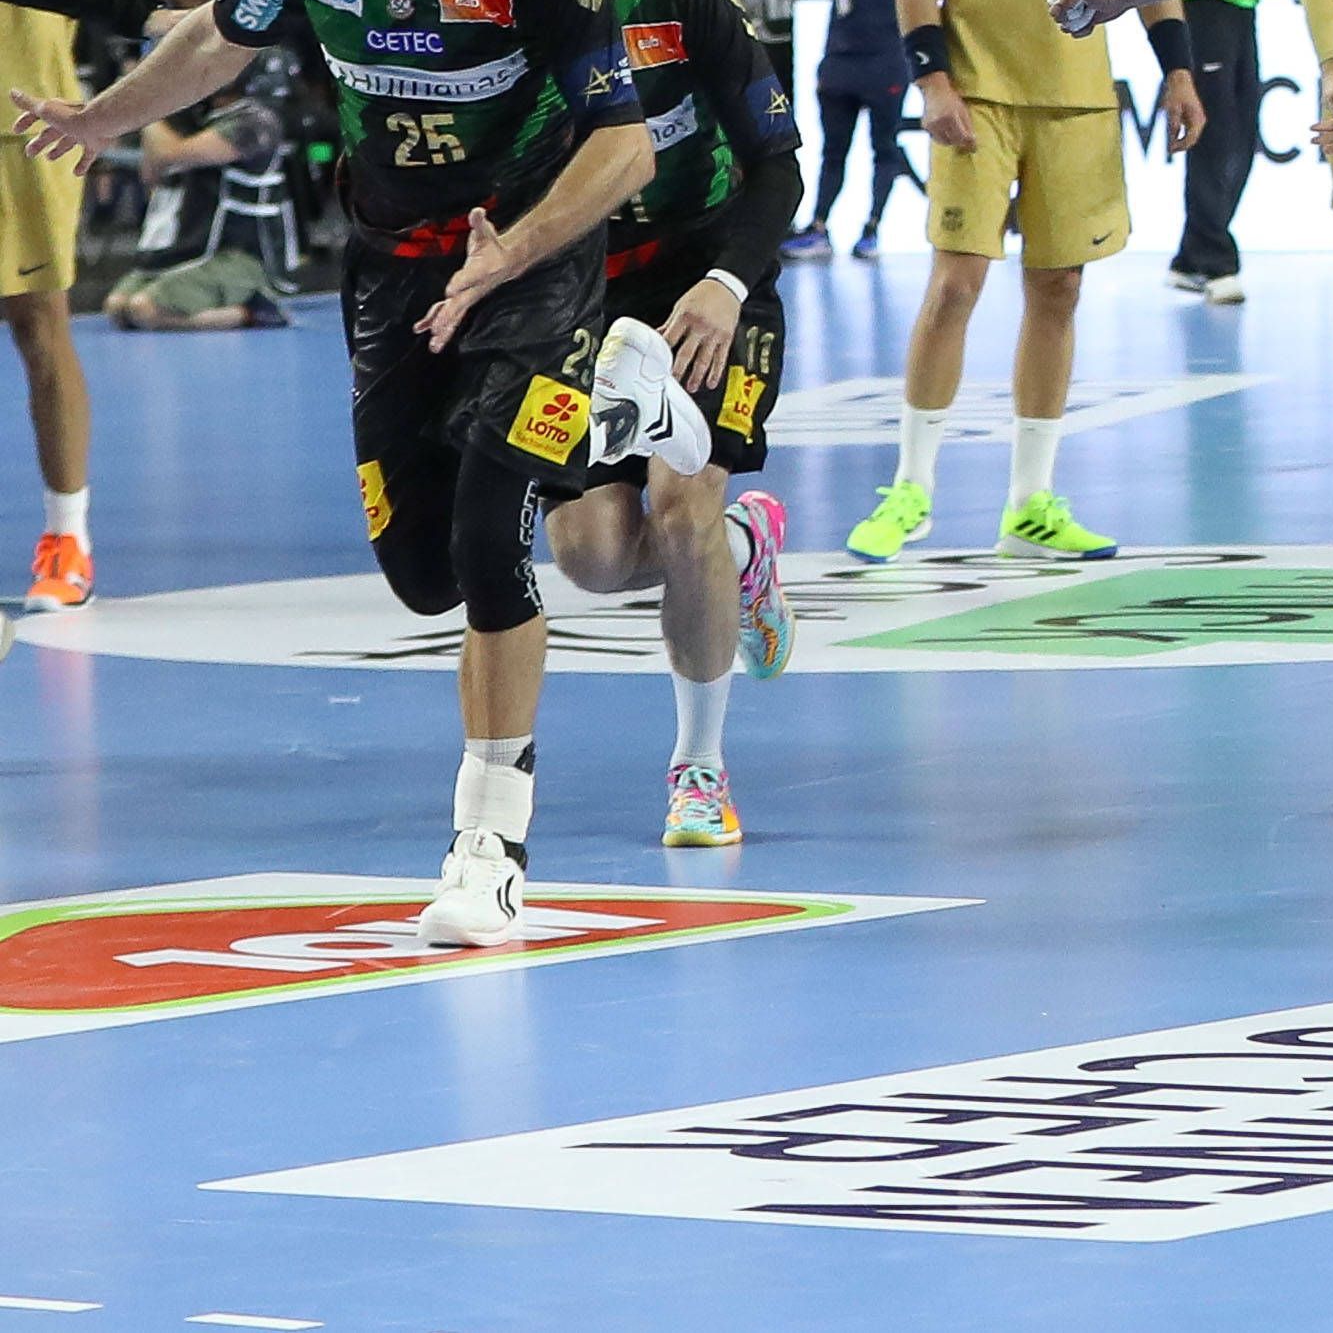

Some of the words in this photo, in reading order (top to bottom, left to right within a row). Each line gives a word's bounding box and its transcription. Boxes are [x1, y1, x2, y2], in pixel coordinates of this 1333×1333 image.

[367, 30, 443, 54] GETEC
[386, 113, 466, 166] 25
[525, 417, 570, 444] LOTTO
